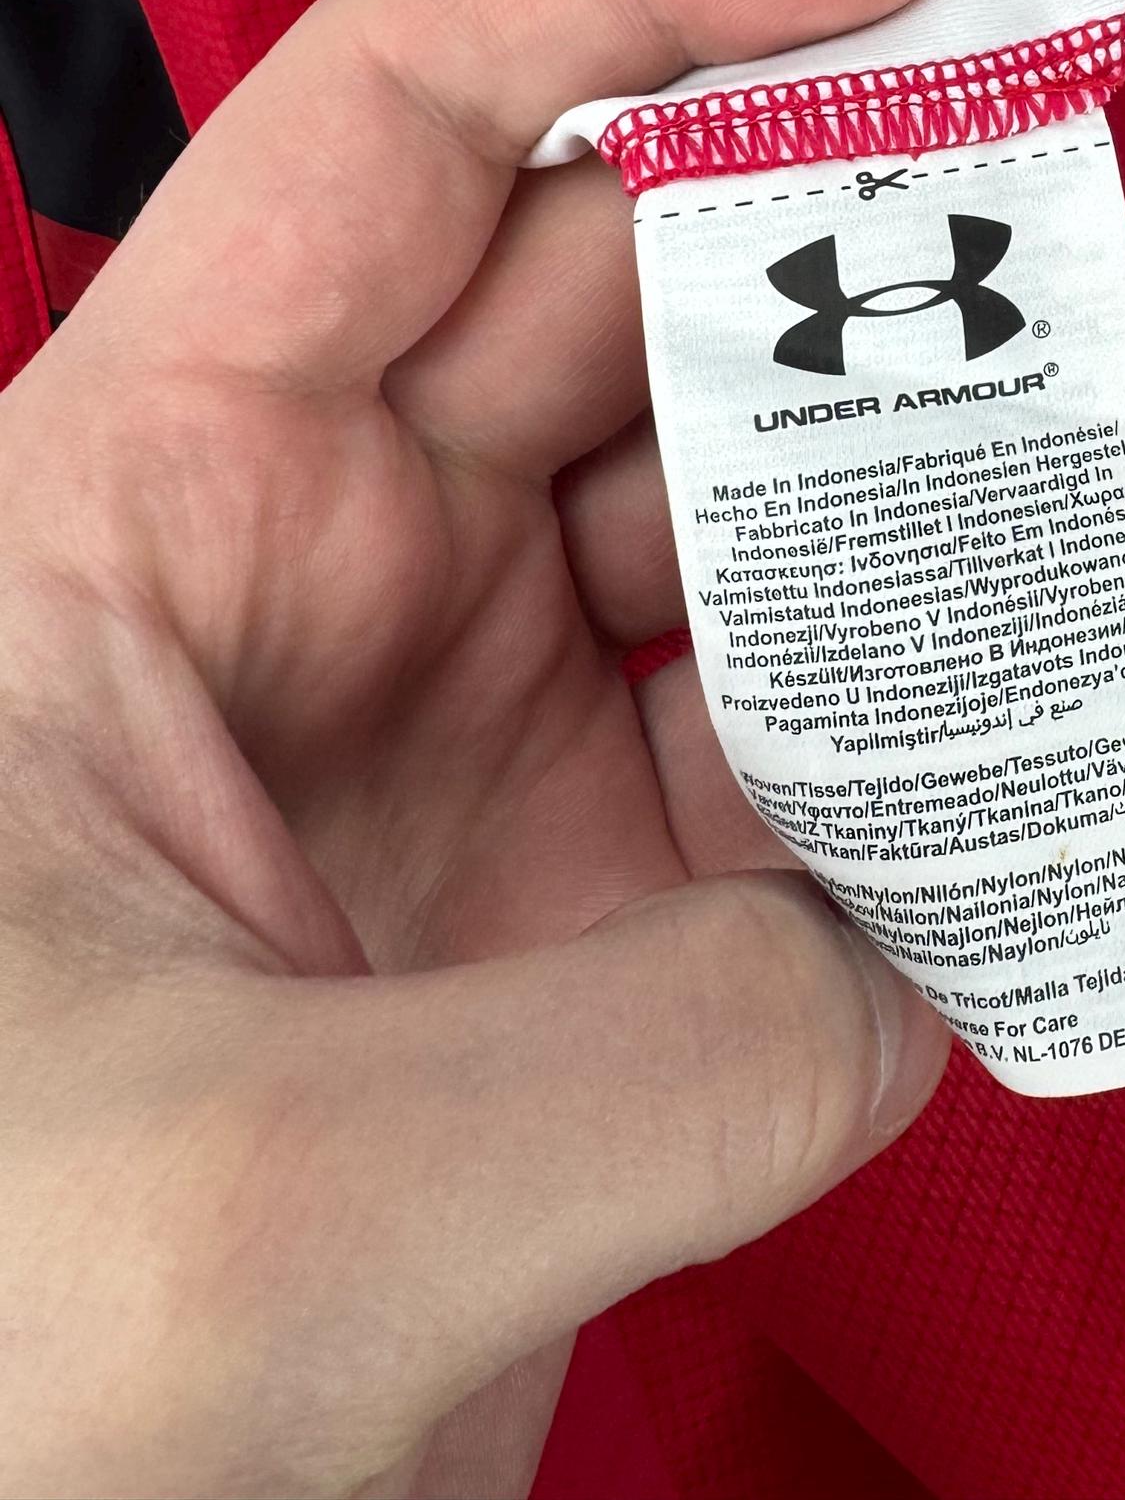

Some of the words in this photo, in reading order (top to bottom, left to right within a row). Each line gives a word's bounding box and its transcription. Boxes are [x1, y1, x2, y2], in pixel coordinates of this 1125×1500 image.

[754, 396, 880, 433] UNDER
[713, 481, 766, 502] Made
[773, 478, 791, 494] In
[798, 442, 986, 491] Indonesia/Fabriqué
[991, 441, 1017, 458] En
[1021, 420, 1118, 453] Indonésie/
[695, 505, 758, 524] Hecho
[764, 501, 791, 518] En
[797, 478, 920, 514] Indonesia/In
[926, 461, 1031, 492] Indonesien
[735, 516, 843, 542] Fabbricato
[850, 510, 868, 527] In
[874, 468, 1090, 523] Indonesia/Vervaardigd
[1095, 466, 1113, 482] In
[1011, 524, 1043, 543] Em
[813, 544, 1045, 598] Indonesiassa/Tillverkat
[719, 602, 835, 626] Valmistatud
[729, 618, 921, 648] Indonezji/Vyrobeno
[925, 608, 940, 627] V
[727, 643, 905, 669] Indonézii/Izdelano
[910, 634, 924, 653] V
[721, 692, 840, 711] Proizvedeno
[846, 687, 860, 704] U
[866, 654, 1073, 703] Indoneziji/Izgatavots
[765, 710, 869, 735] Pagaminta
[950, 980, 1069, 1009] Tricot/Malla
[994, 1021, 1027, 1037] For
[1033, 1014, 1078, 1035] Care
[1013, 1036, 1093, 1063] NL-1076
